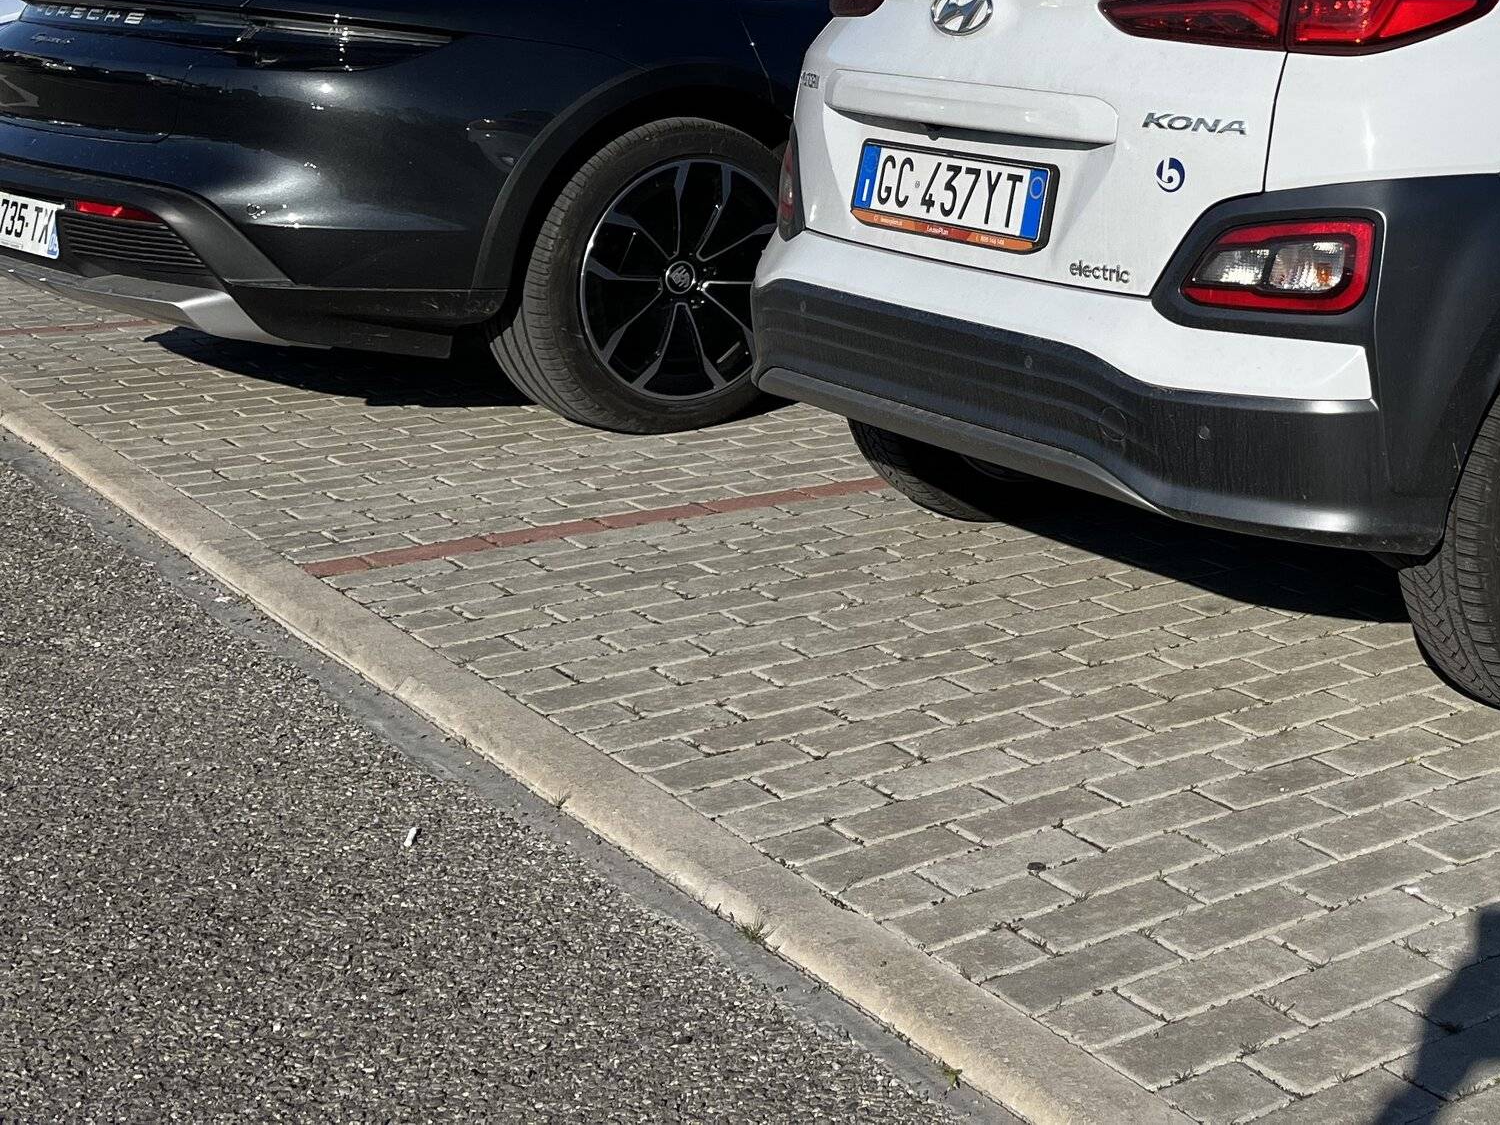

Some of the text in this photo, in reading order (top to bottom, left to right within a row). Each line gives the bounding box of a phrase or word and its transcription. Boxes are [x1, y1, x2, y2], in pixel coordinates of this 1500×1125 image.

[1142, 112, 1247, 135] KONA
[877, 155, 914, 208] GC
[920, 161, 1024, 228] 437YT
[1070, 260, 1130, 283] electric
